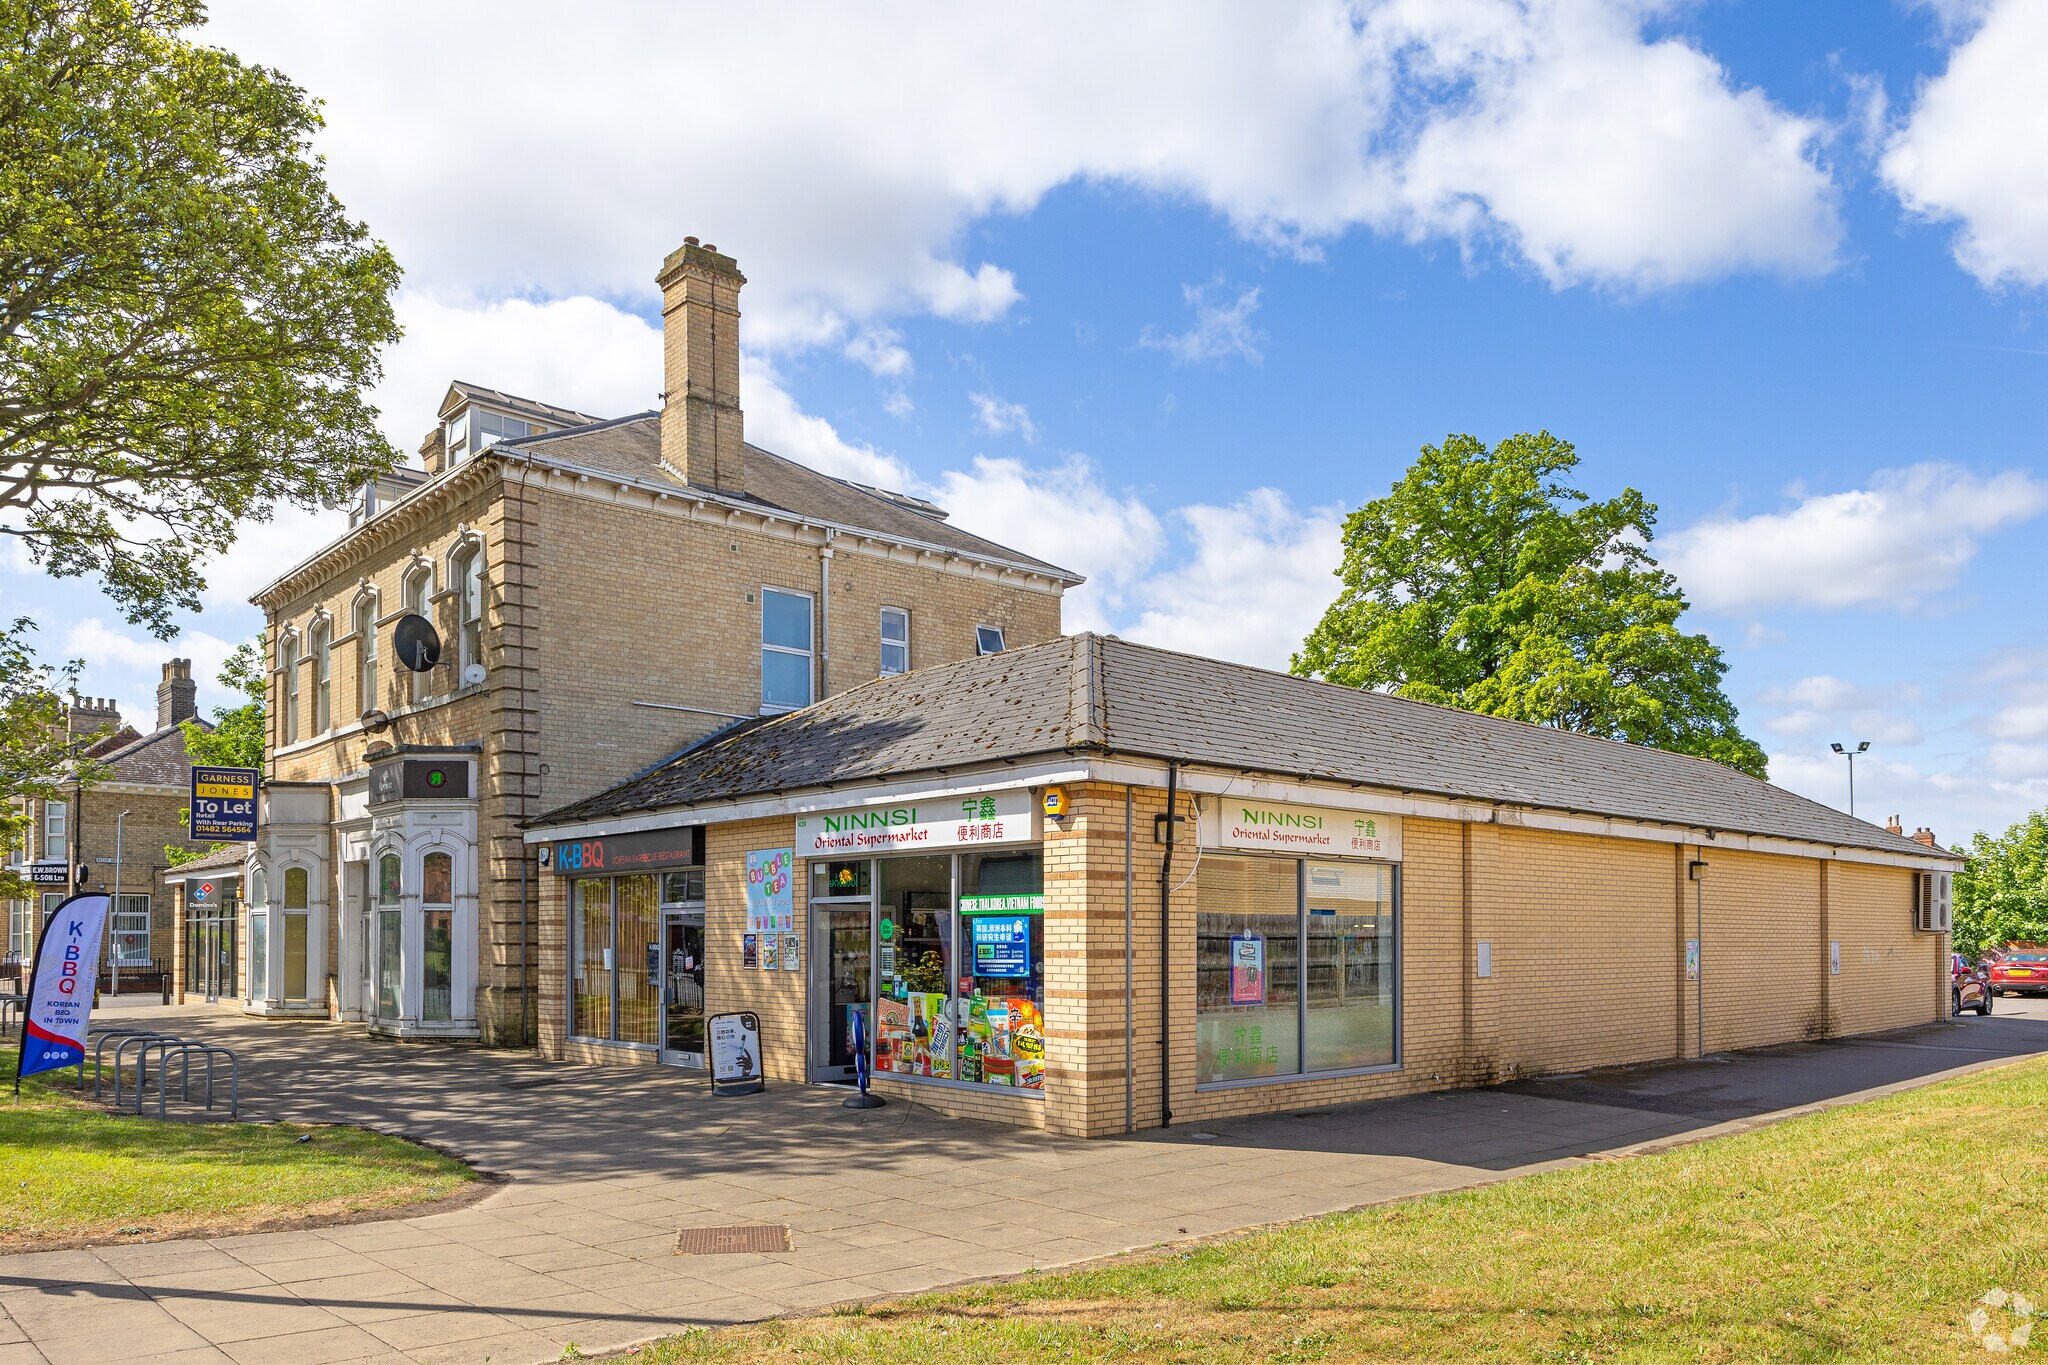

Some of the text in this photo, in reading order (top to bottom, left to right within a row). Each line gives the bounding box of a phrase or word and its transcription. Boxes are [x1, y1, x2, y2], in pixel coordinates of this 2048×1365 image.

[201, 774, 249, 783] GARNESS
[201, 787, 248, 795] JONES
[196, 800, 252, 814] To Let
[962, 796, 996, 822] 宁鑫
[823, 808, 916, 833] NINNSI
[1242, 808, 1322, 829] NINNSI
[814, 827, 928, 849] Oriental Supermarket
[957, 822, 1004, 841] 便利商店
[1232, 827, 1330, 845] Oriental Supermarket
[1351, 837, 1381, 851] 便利商店
[559, 841, 605, 870] K-BBQ
[658, 848, 690, 861] RESTAURANT
[750, 854, 789, 881] BUBBLE
[766, 876, 786, 894] TEA
[47, 1000, 80, 1008] KOREAN
[55, 1017, 79, 1025] TOWN
